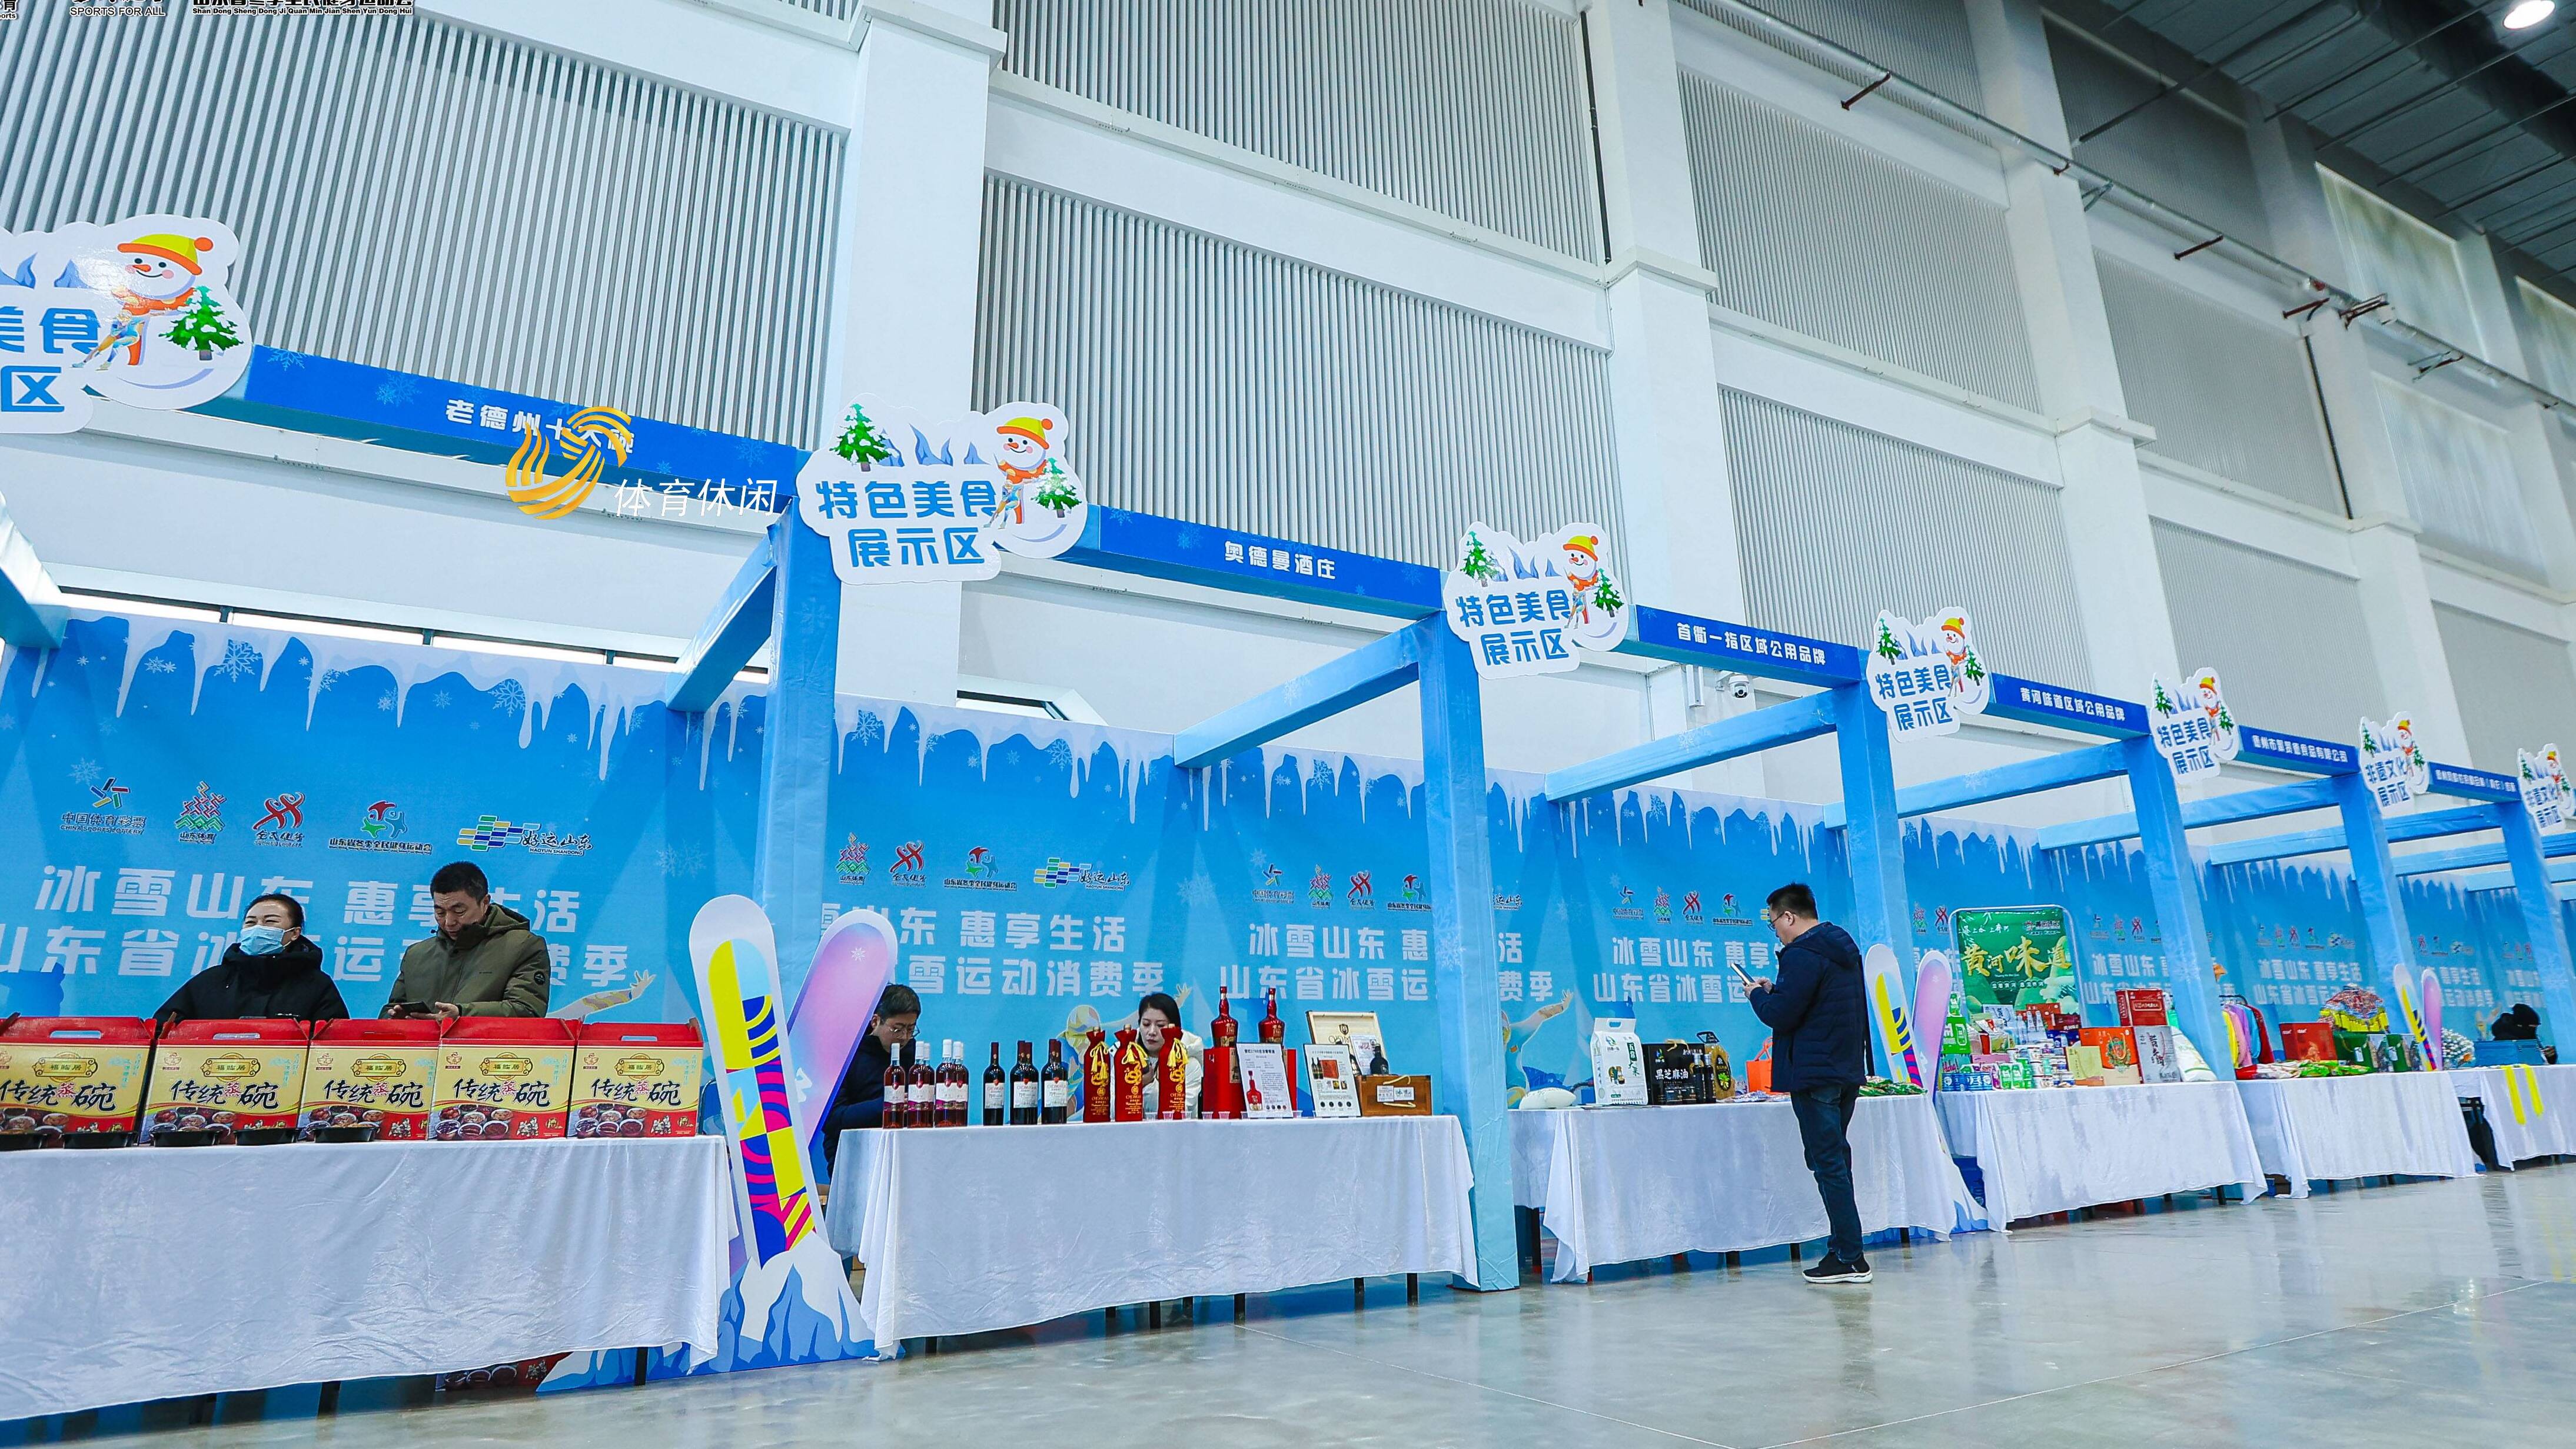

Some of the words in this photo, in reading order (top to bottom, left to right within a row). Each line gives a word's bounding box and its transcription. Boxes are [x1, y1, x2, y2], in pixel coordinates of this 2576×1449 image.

[1, 365, 65, 413] 区
[815, 480, 998, 520] 特色美食
[847, 527, 985, 567] 展示区
[1224, 540, 1336, 580] 奥德曼酒庄
[1455, 589, 1571, 627] 特色美食
[1480, 628, 1570, 666] 展示区
[1875, 663, 1952, 700] 特色美食
[1893, 697, 1953, 732] 展示区
[2020, 686, 2126, 722] 黄河味道区域公用品牌
[2156, 717, 2212, 749] 特色美食
[2172, 745, 2215, 775] 展示区
[2377, 781, 2411, 807] 展示区
[62, 812, 147, 828] 中国体育彩票
[180, 832, 216, 841] 山东体育
[522, 830, 594, 850] 好运山东
[1079, 870, 1130, 886] 好运山东
[1493, 894, 1523, 906] 运山东
[960, 910, 1125, 952] 惠享生活
[1248, 923, 1385, 960] 冰雪山东
[1613, 936, 1713, 968] 冰雪山东
[1961, 935, 2072, 978] 黄河味道
[2092, 953, 2156, 977] 冰雪山东
[893, 955, 1164, 998] 雪运动消费季
[1593, 973, 1770, 1003] 山东省冰雪运
[1655, 1068, 1689, 1081] 黑芝麻油
